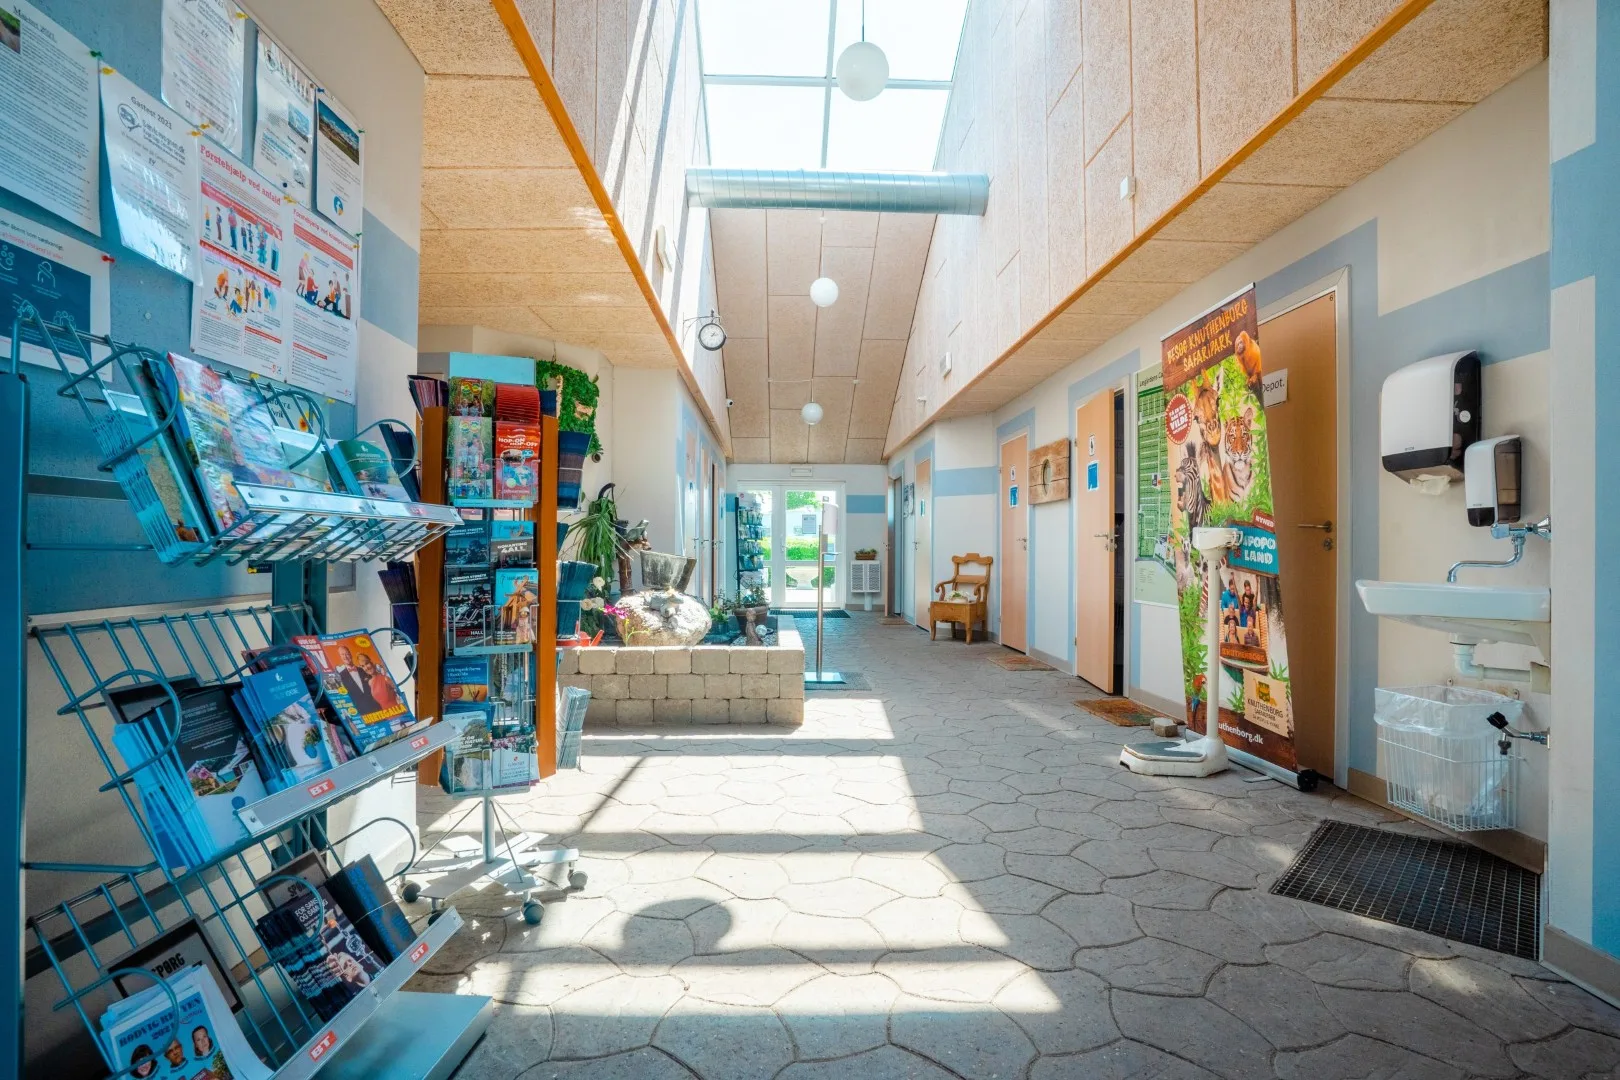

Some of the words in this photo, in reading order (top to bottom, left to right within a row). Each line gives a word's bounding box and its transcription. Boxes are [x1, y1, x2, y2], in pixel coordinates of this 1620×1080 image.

[1167, 340, 1188, 364] BESØG
[1189, 299, 1248, 350] KNUTHENBORG
[1183, 330, 1232, 371] SAFARIPARK
[1170, 413, 1188, 431] VILDE
[1255, 515, 1275, 528] NYHED
[1243, 535, 1276, 550] POPO
[1244, 549, 1273, 565] LAND
[1221, 647, 1265, 662] KNUTHENBORG
[1247, 698, 1284, 719] KNUTHENBORG
[1218, 722, 1264, 745] uthenborg.dk
[411, 737, 425, 748] BT
[310, 781, 329, 796] BT
[411, 945, 425, 961] BT
[311, 1035, 330, 1058] BT
